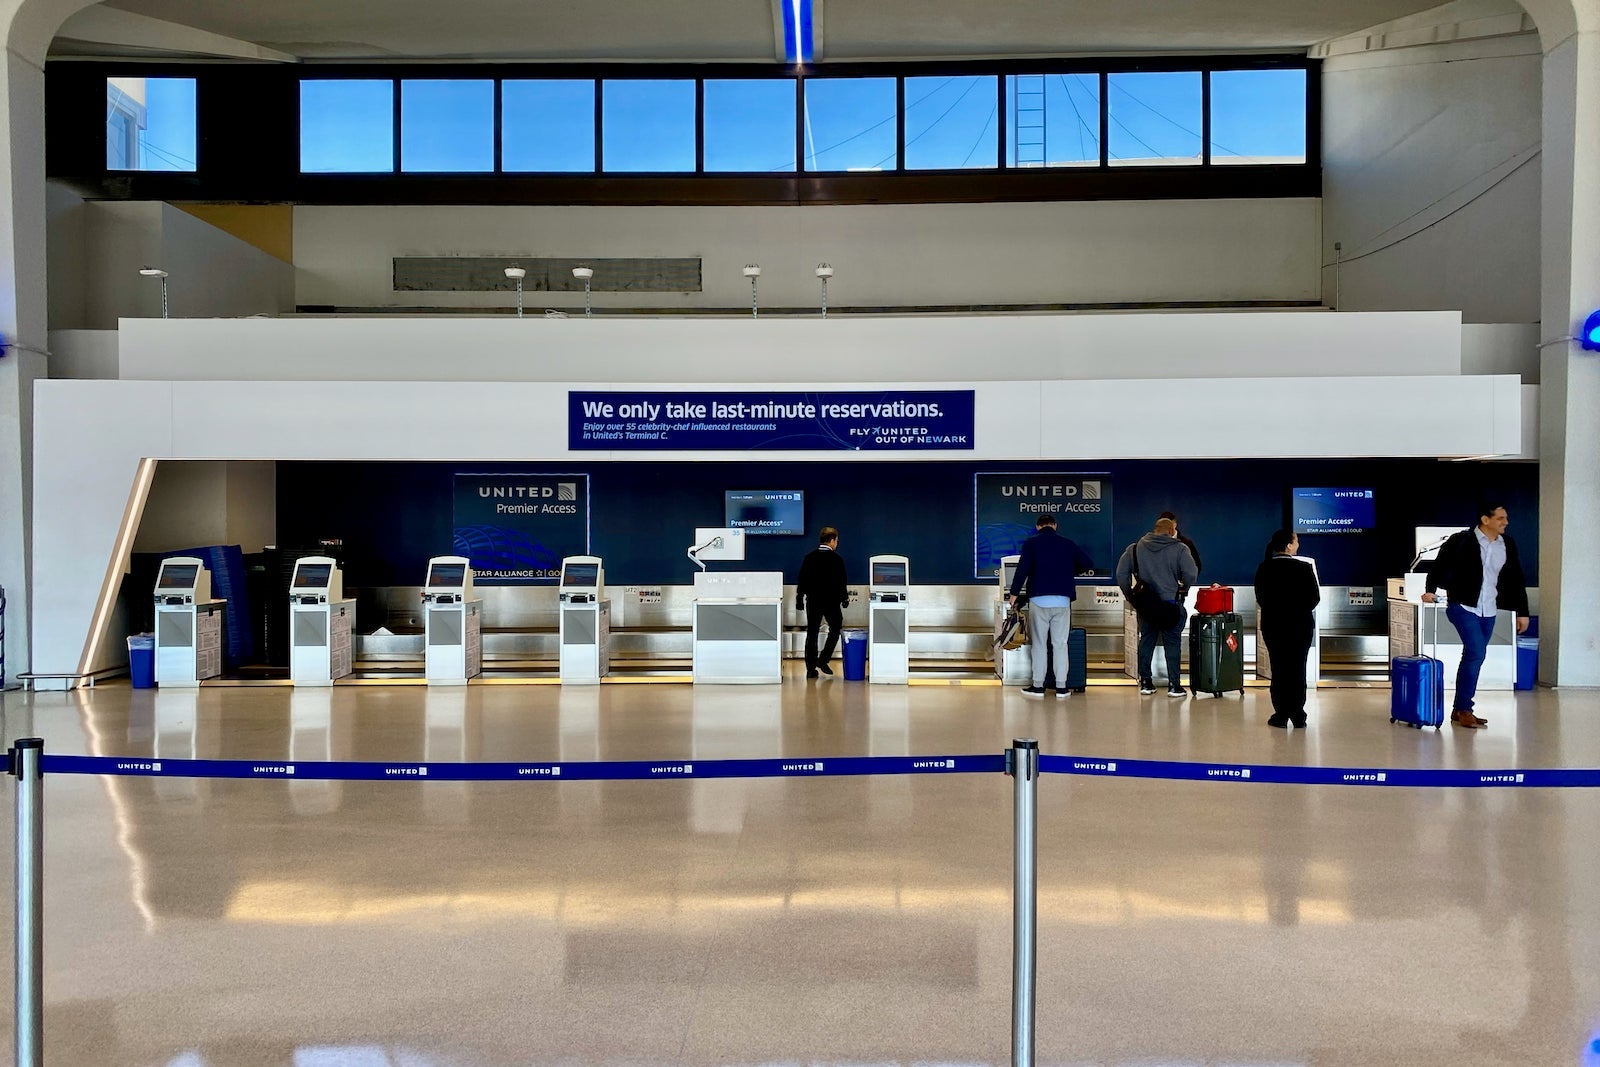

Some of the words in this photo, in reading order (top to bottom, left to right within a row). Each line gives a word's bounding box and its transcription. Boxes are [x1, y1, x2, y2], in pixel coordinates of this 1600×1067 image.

[583, 401, 614, 418] We
[618, 400, 659, 423] only
[665, 400, 706, 418] take
[711, 400, 816, 418] last-minute
[821, 400, 944, 418] reservations.
[582, 422, 605, 432] Enjoy
[606, 423, 625, 431] over
[626, 422, 636, 431] 55
[638, 421, 690, 432] celebrity-chef
[692, 421, 730, 431] influenced
[732, 422, 777, 431] restaurants
[583, 431, 591, 440] in
[592, 431, 624, 440] United's
[625, 431, 659, 440] Terminal
[660, 431, 668, 440] C.
[849, 427, 870, 436] FLY
[881, 427, 928, 435] UNITED
[875, 436, 898, 444] OUT
[900, 436, 914, 444] OF
[917, 435, 966, 444] NEWARK
[478, 487, 554, 498] UNITED
[1001, 486, 1077, 497] UNITED
[496, 503, 538, 514] Premier
[541, 503, 577, 514] Access
[1020, 502, 1061, 513] Premier
[1065, 502, 1101, 513] Access
[914, 760, 946, 768] UNITED
[1074, 762, 1107, 770] UNITED
[1208, 769, 1241, 777] UNITED
[1343, 773, 1376, 781] UNITED
[1480, 774, 1515, 782] UNITED
